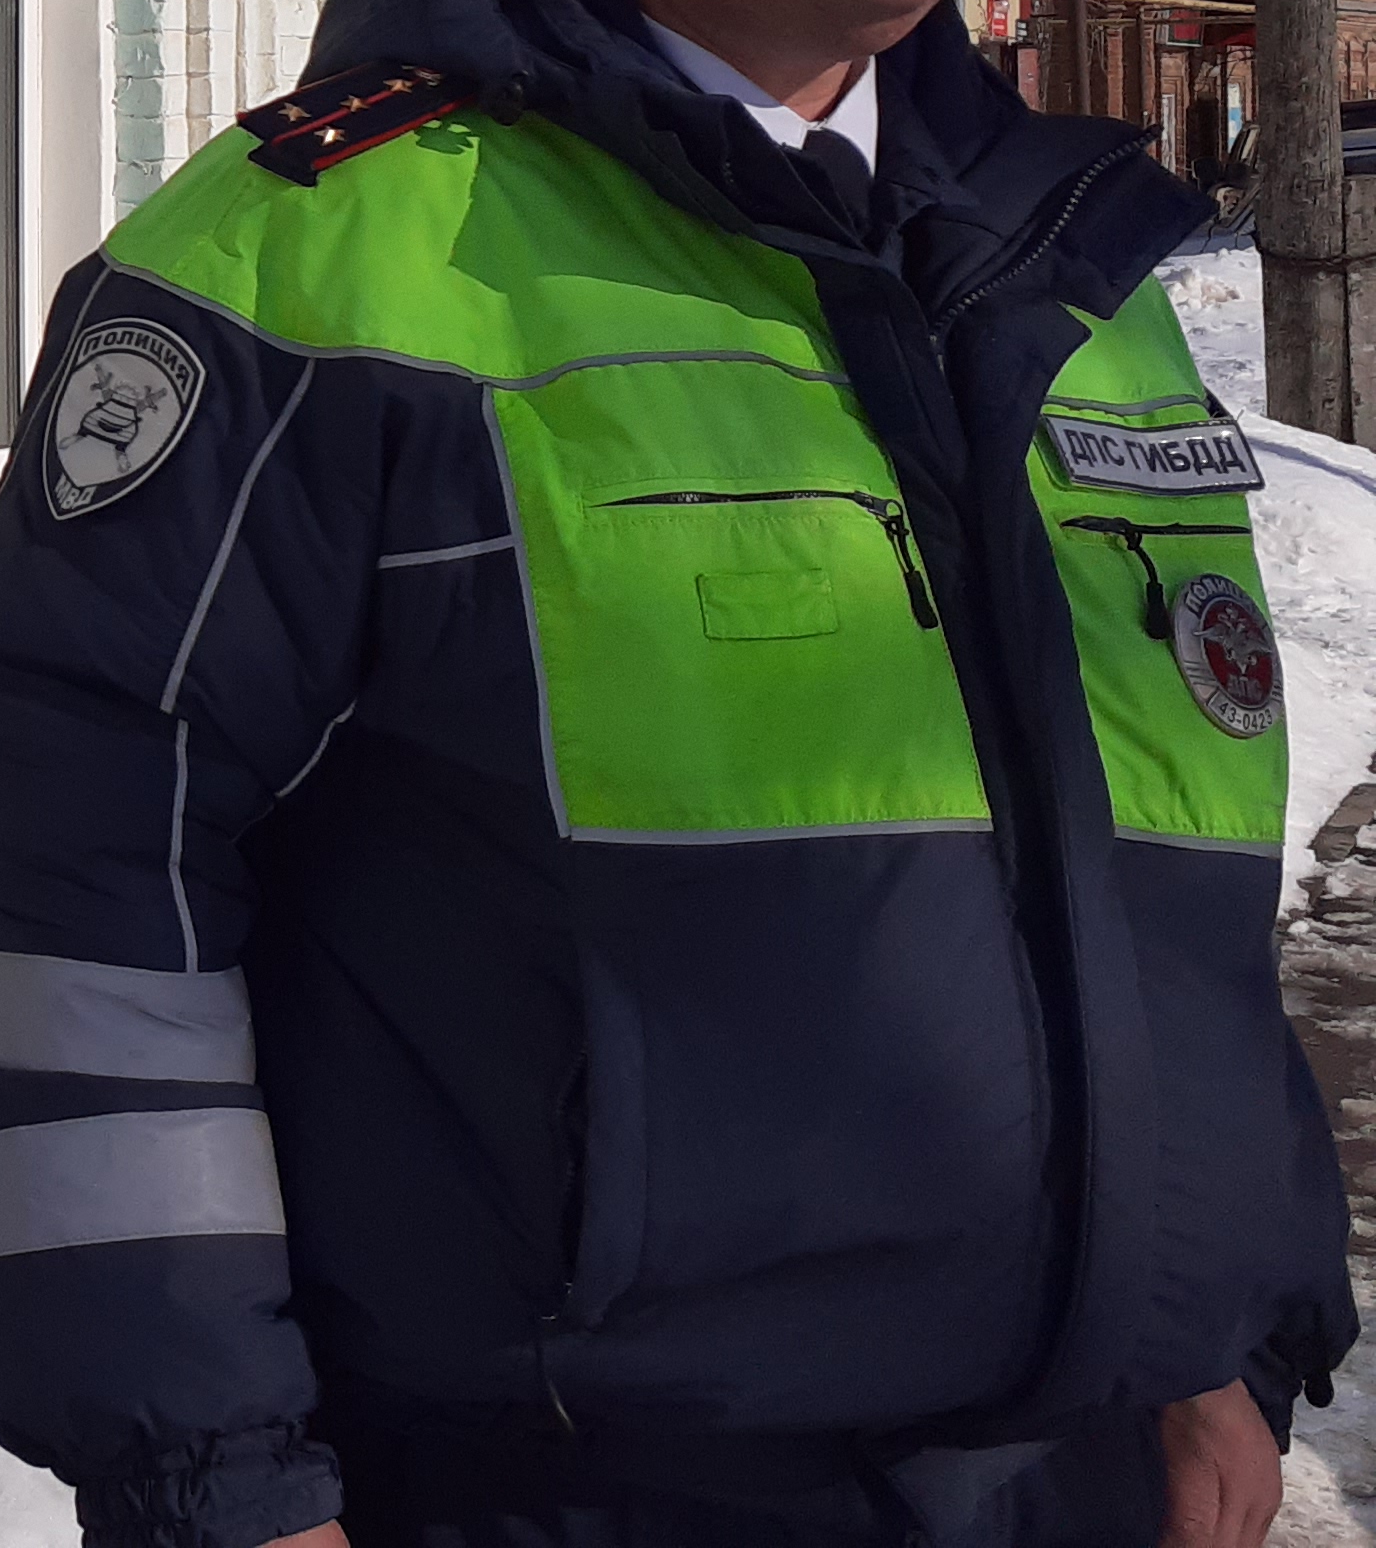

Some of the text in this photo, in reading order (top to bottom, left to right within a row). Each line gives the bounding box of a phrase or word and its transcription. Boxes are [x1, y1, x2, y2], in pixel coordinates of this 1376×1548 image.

[82, 330, 191, 393] ПОЛИЦИЯ
[1063, 428, 1247, 476] ДПС ГИБДД
[54, 473, 98, 510] МВД
